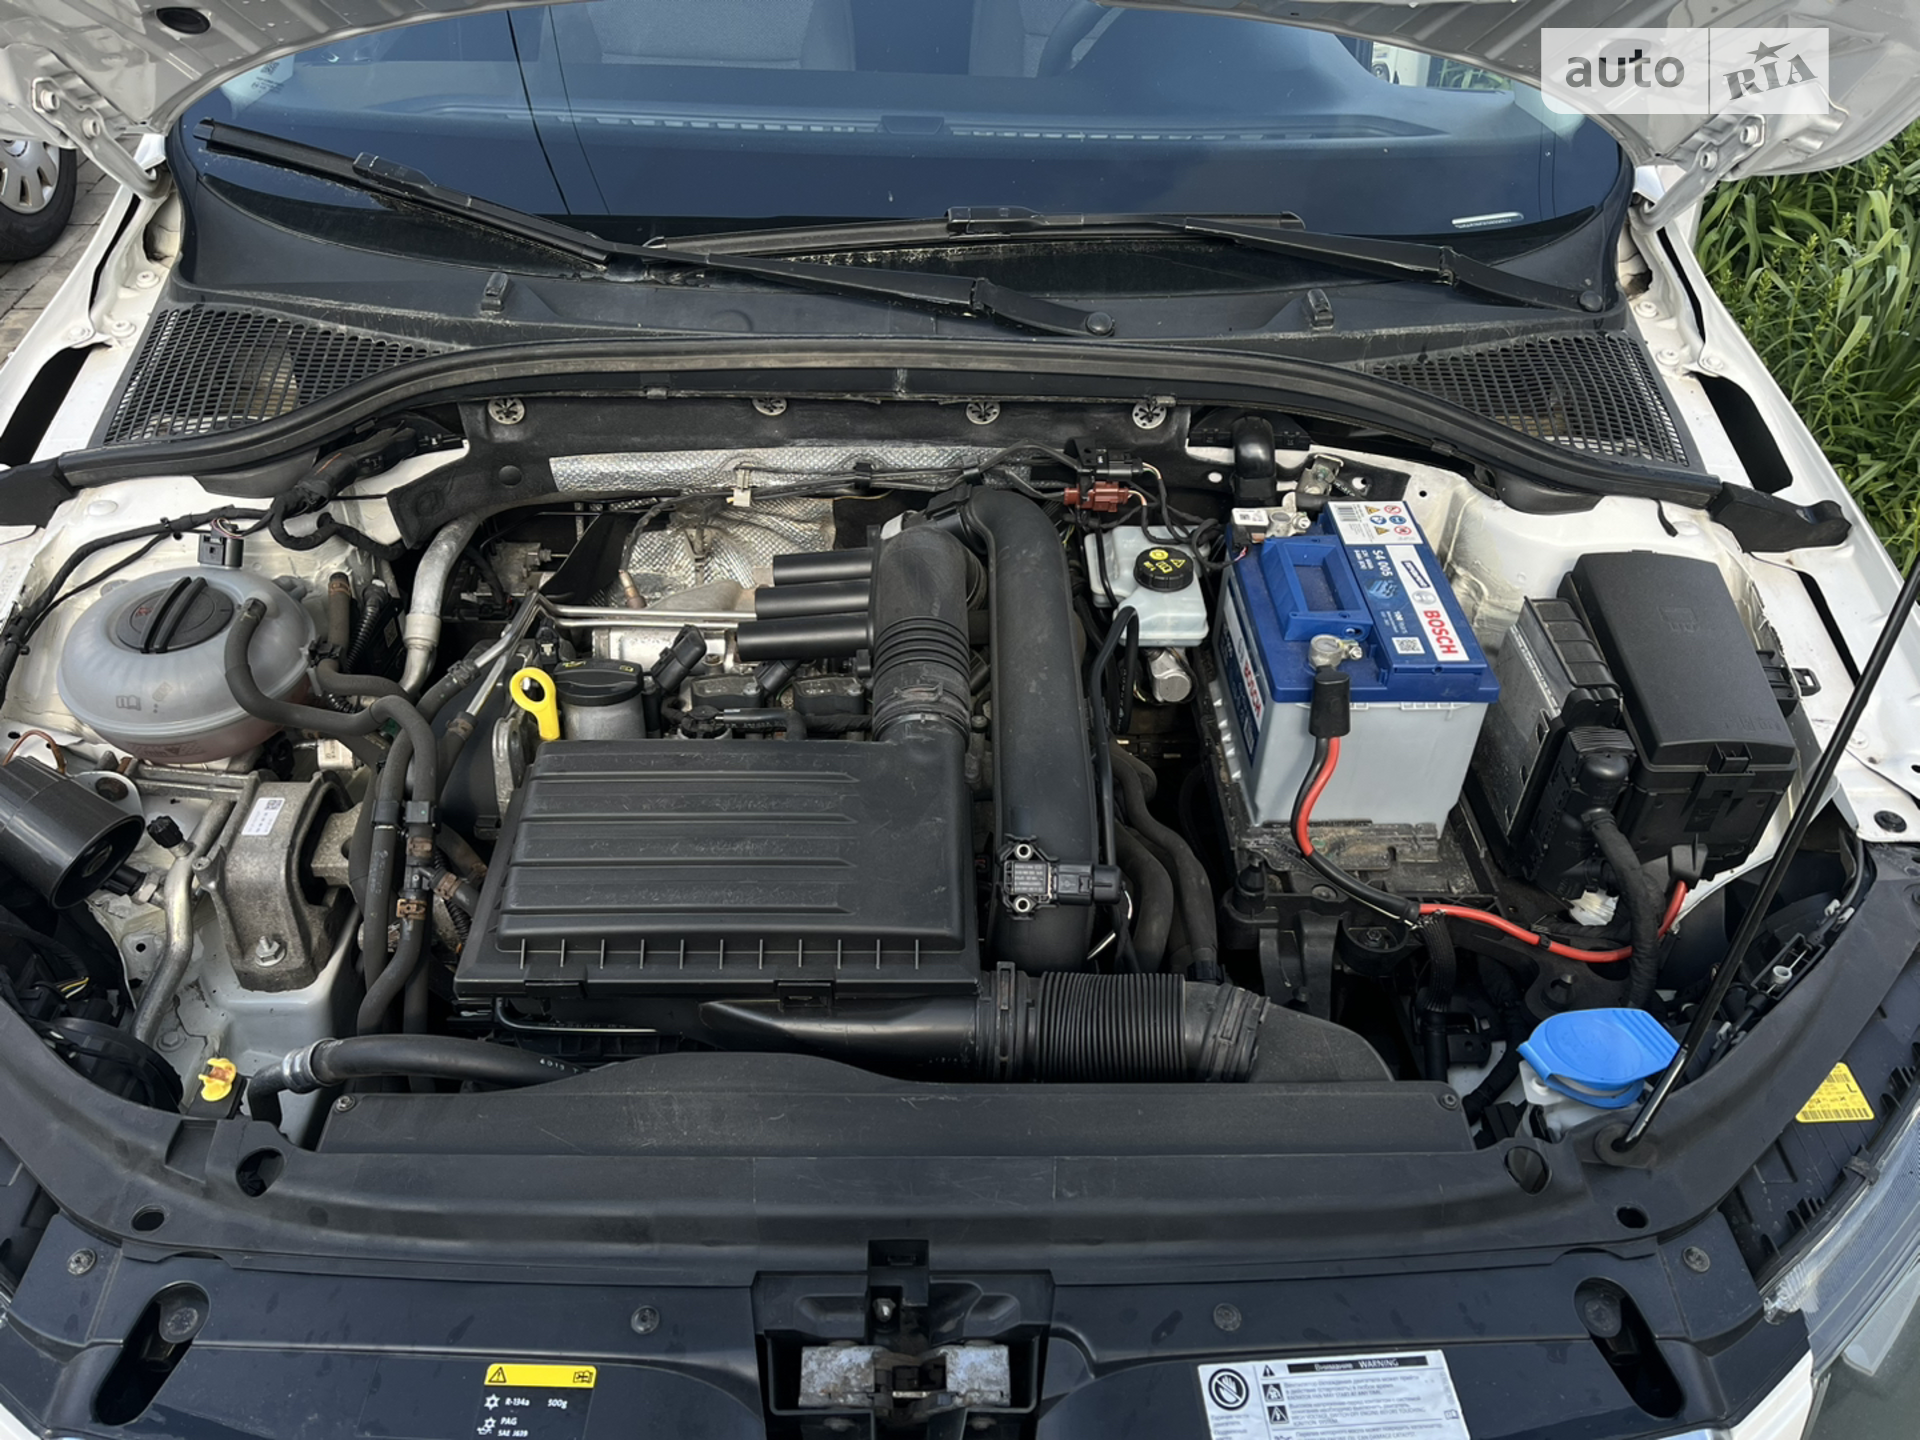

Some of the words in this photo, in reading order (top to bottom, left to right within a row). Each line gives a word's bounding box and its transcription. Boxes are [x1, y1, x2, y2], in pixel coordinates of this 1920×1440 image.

[1423, 609, 1459, 655] BOSCH
[1358, 1358, 1399, 1369] WARNING
[504, 1396, 531, 1407] R-134a
[547, 1398, 569, 1410] 500g
[500, 1416, 518, 1426] PAG
[497, 1428, 511, 1437] SAE
